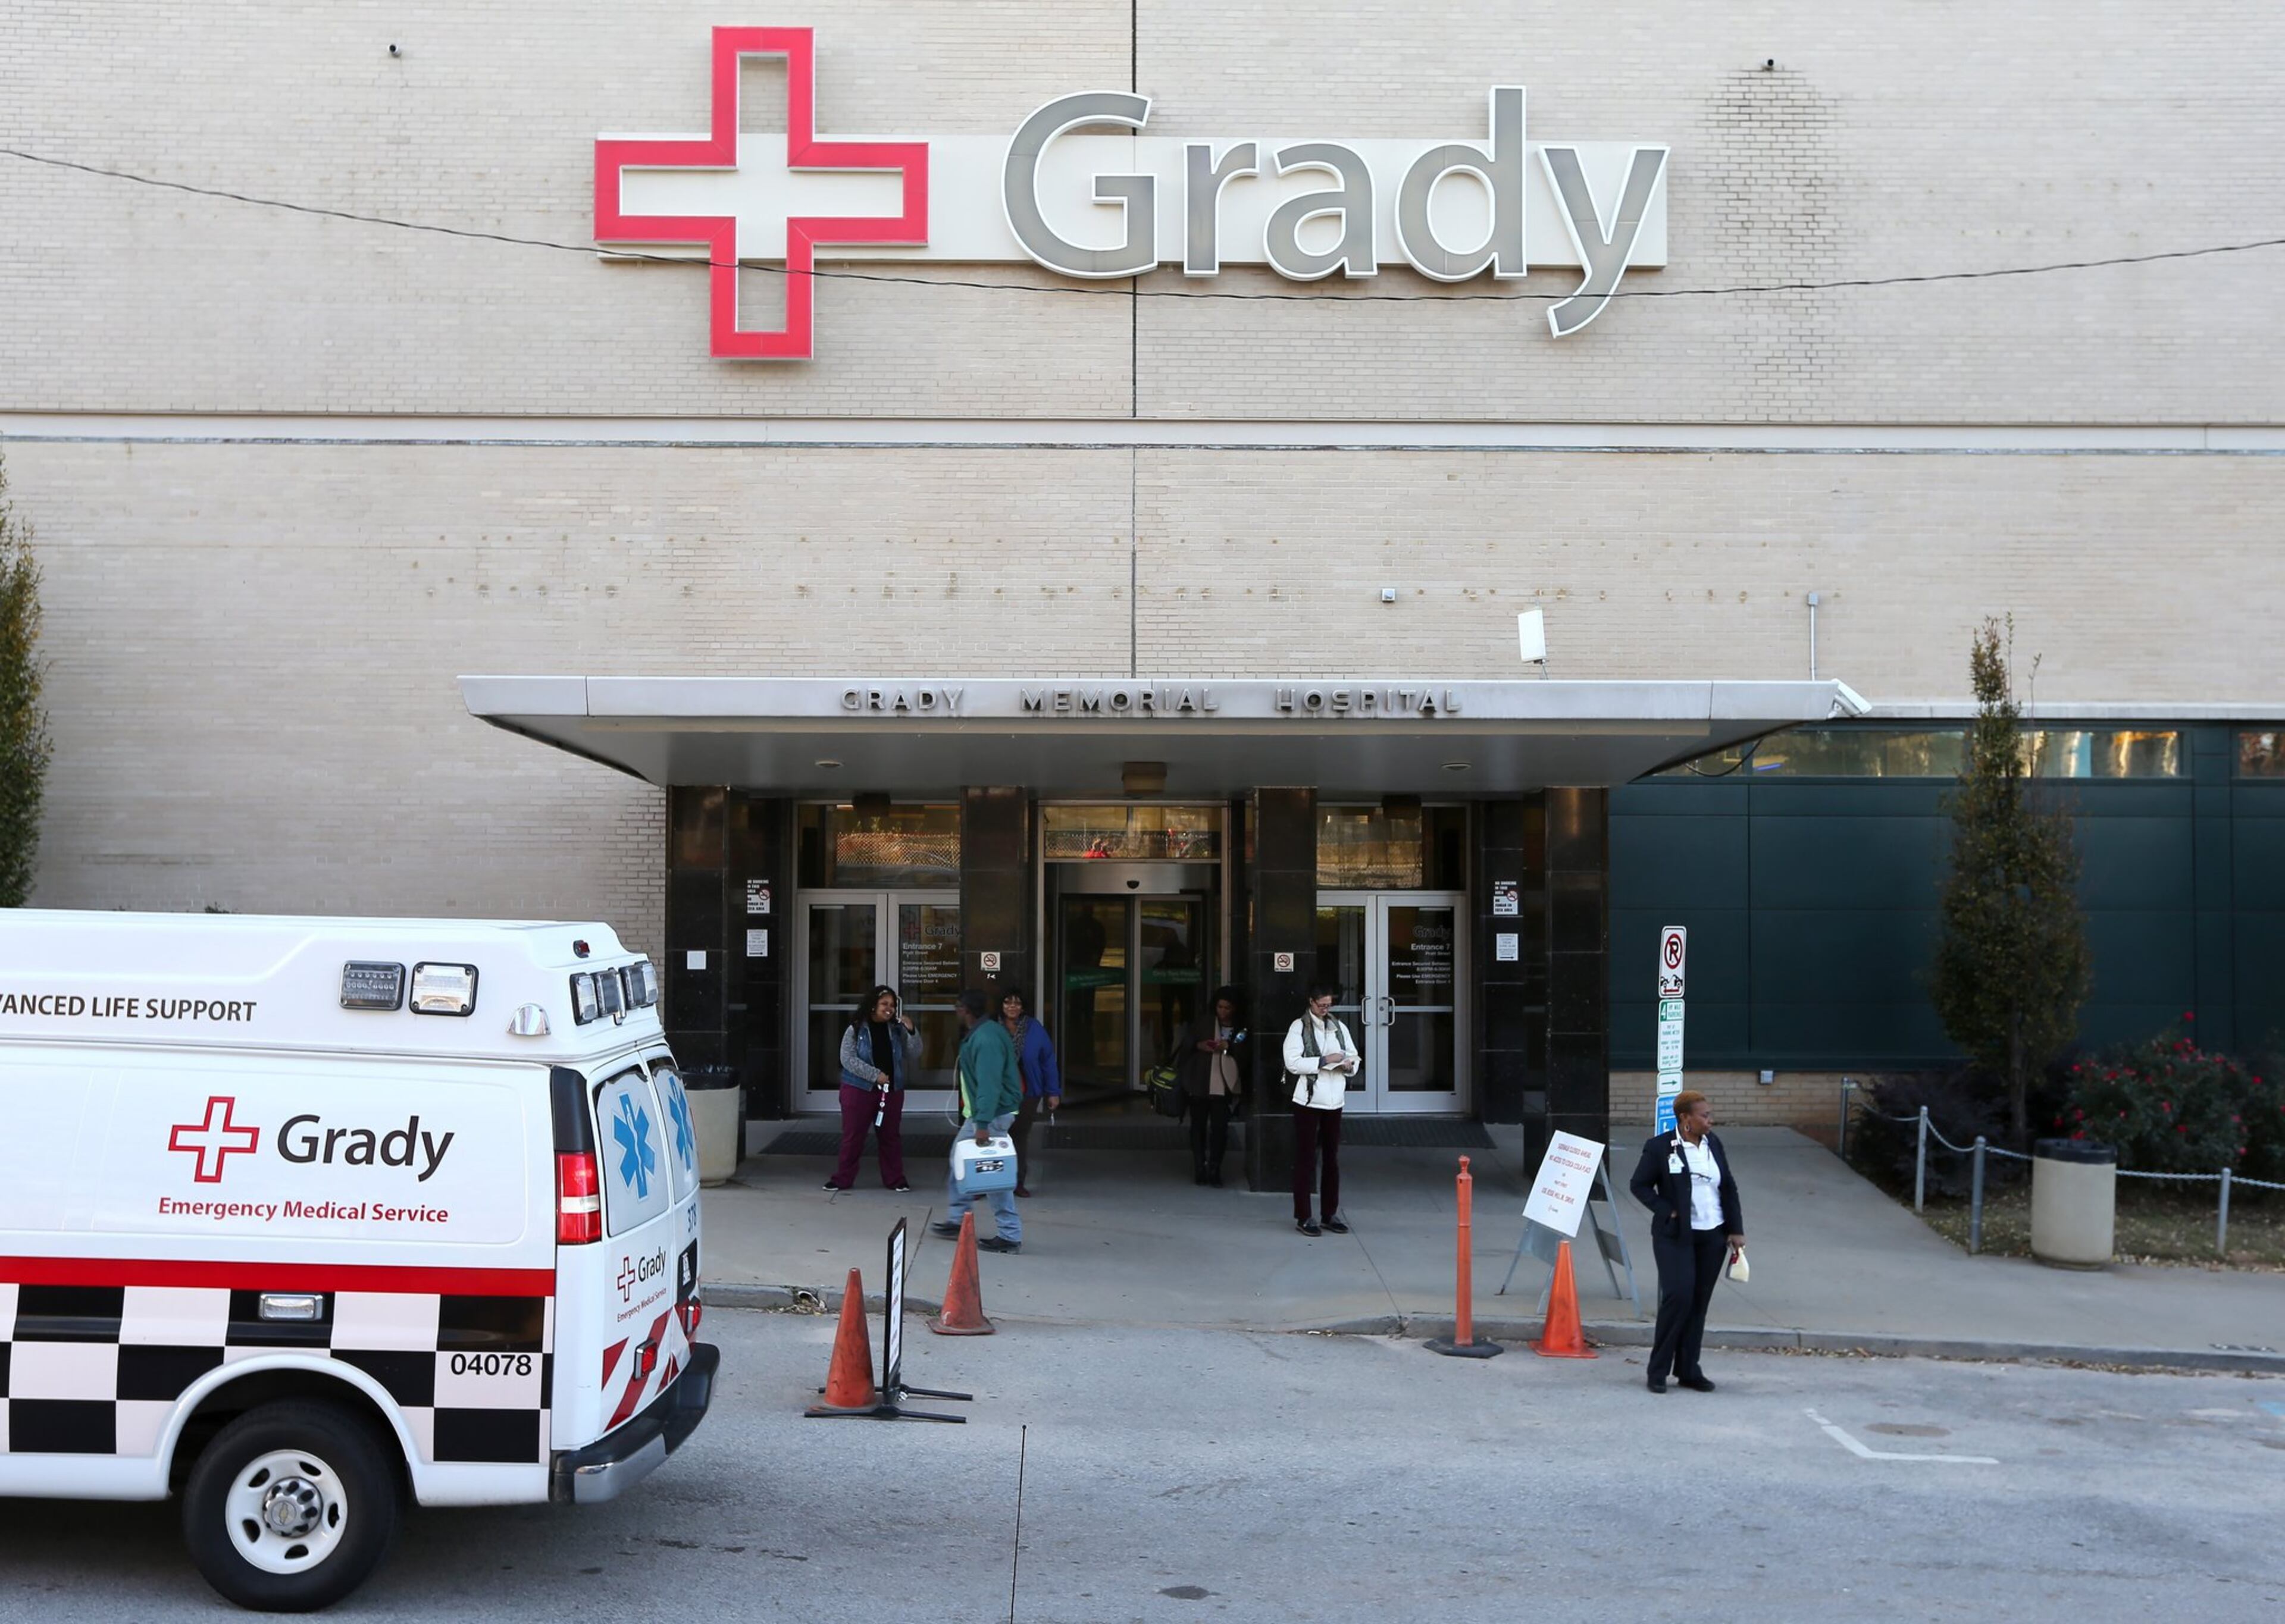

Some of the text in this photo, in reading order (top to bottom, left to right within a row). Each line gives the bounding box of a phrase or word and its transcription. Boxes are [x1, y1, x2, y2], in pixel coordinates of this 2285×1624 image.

[1001, 86, 1670, 338] Grady
[841, 688, 1463, 711] GRADY MEMORIAL HOSPITAL
[92, 996, 140, 1018] LIFE
[145, 999, 256, 1021] SUPPORT
[1661, 1004, 1667, 1020] 4
[277, 1114, 455, 1182] Grady
[158, 1197, 449, 1222] Emergency Medical Service
[638, 1246, 666, 1283] Grady
[617, 1287, 667, 1323] Emergency Medical Service
[450, 1353, 532, 1377] 04078
